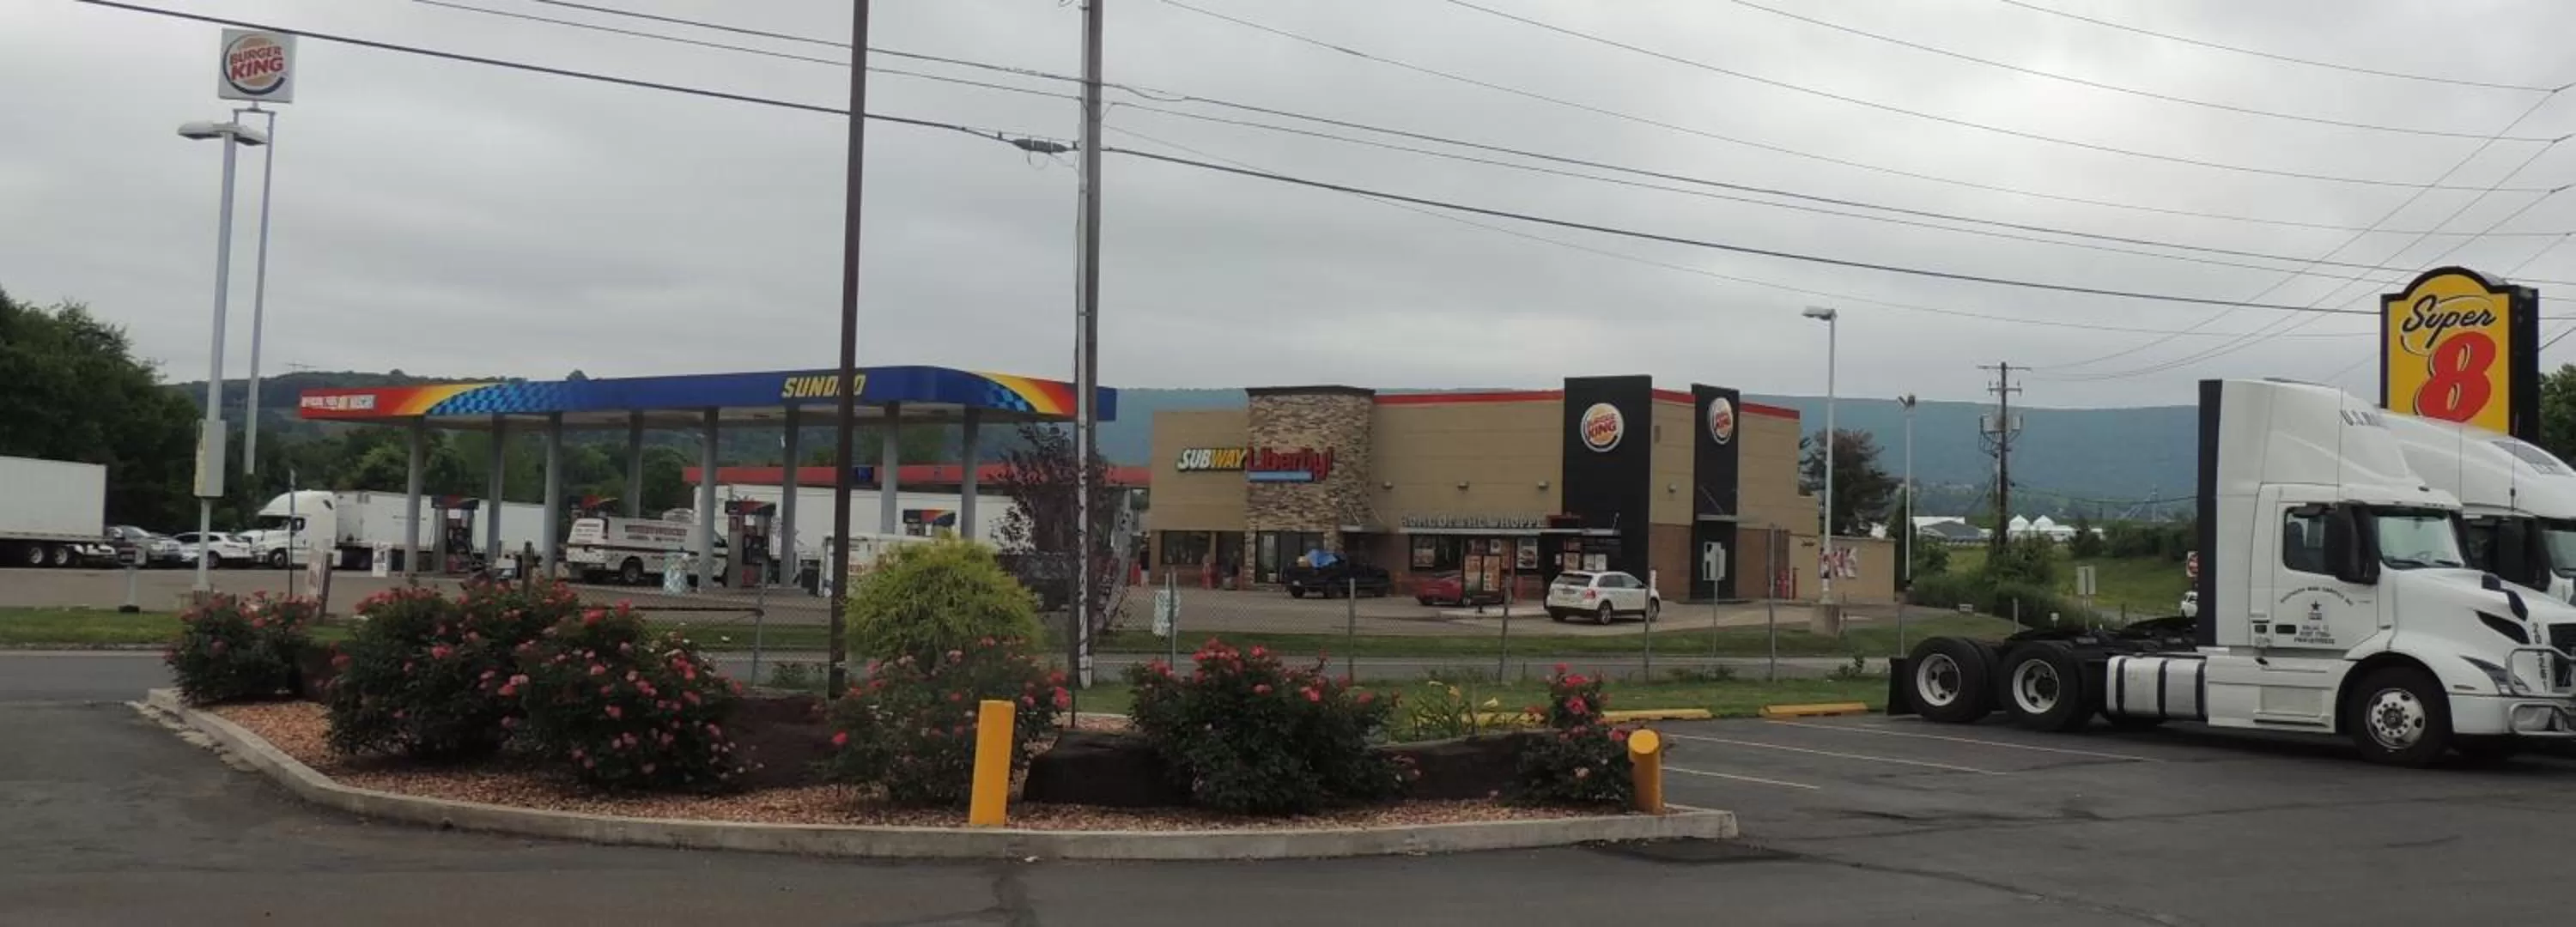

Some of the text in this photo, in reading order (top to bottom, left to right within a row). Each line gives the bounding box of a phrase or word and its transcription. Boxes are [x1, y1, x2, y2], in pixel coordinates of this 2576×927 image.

[229, 46, 282, 65] BURGER
[231, 57, 284, 80] KING
[2403, 294, 2497, 349] Super
[781, 374, 866, 398] SUNOO
[2415, 330, 2497, 422] 8
[1589, 420, 1617, 438] KING
[1177, 448, 1246, 470] SUBWAY
